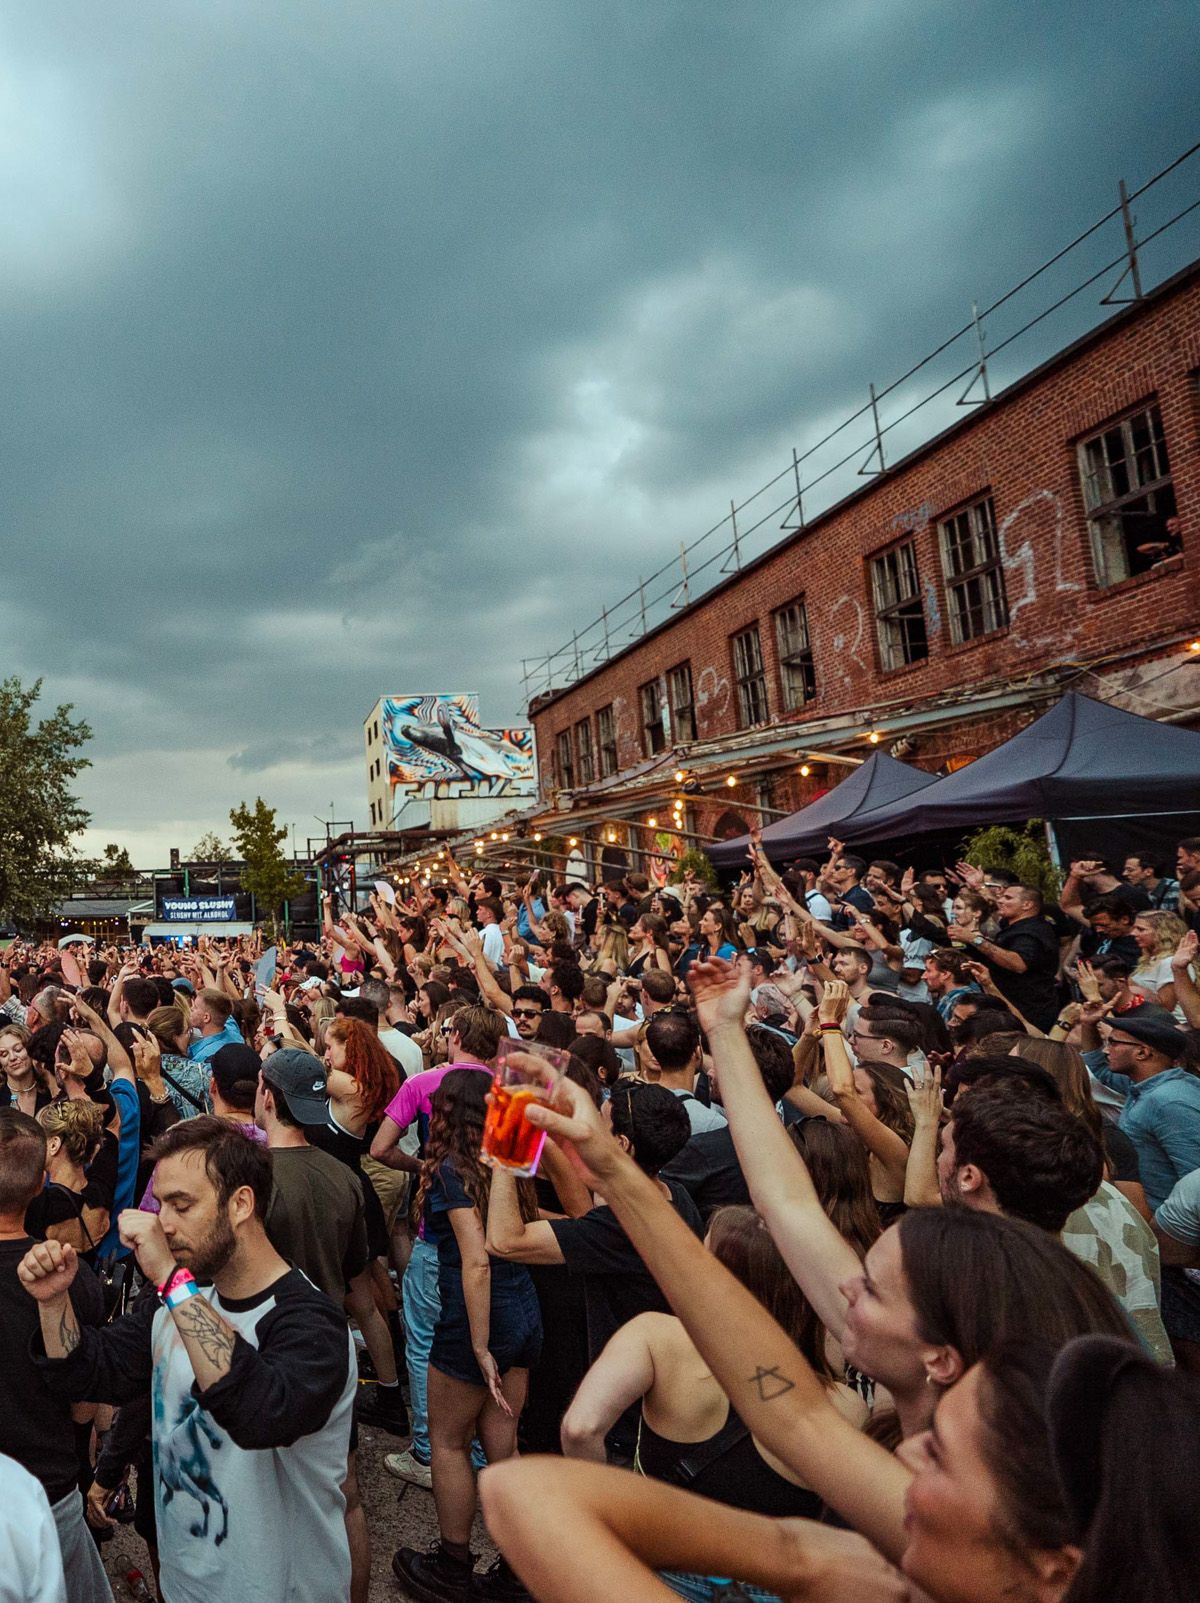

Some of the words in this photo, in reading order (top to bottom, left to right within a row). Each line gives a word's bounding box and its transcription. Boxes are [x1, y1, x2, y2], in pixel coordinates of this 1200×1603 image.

[164, 902, 198, 910] YOUNG
[198, 900, 234, 910] SLUSHY
[170, 911, 191, 919] SLUSHY
[203, 910, 229, 918] ALKOHOL
